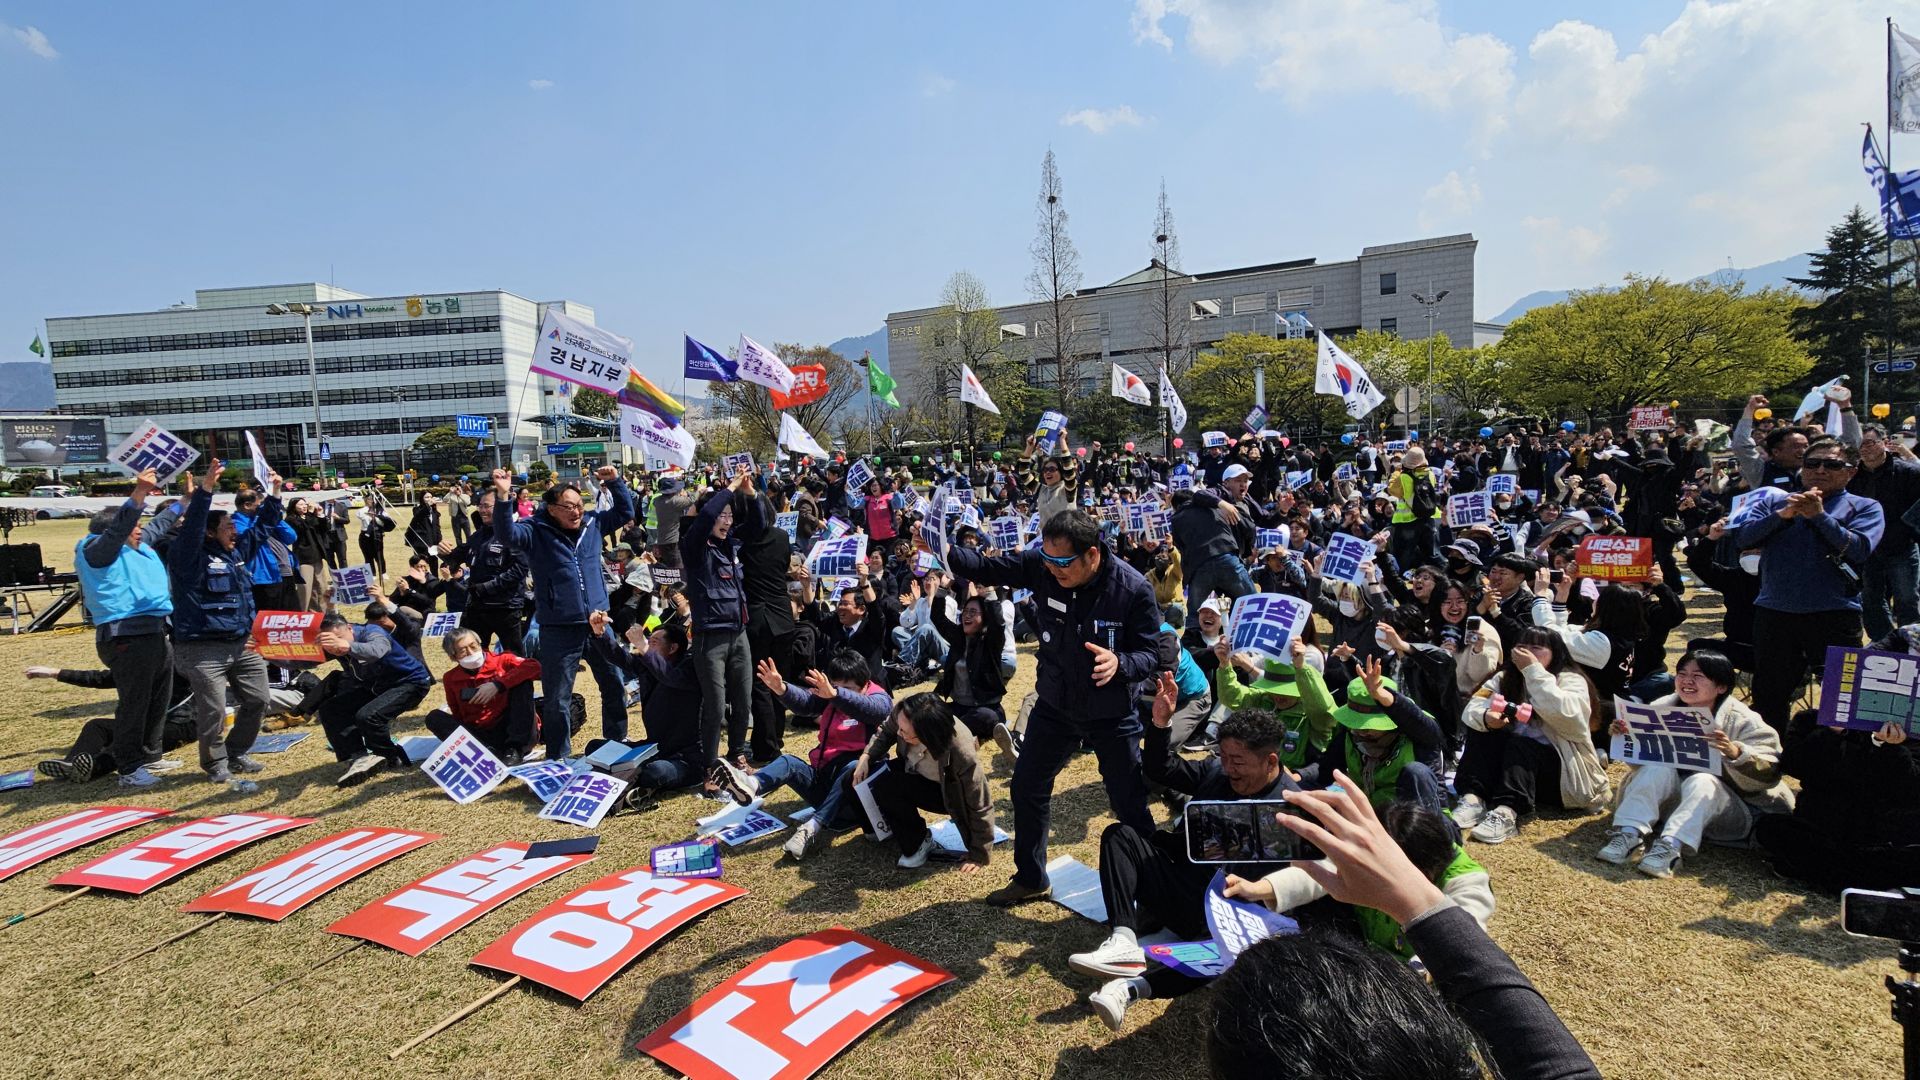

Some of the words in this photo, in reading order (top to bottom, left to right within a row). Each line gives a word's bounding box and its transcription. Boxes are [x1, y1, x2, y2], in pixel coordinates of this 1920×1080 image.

[327, 304, 363, 319] NH
[426, 297, 460, 314] 농협
[891, 325, 920, 337] 한국은행
[550, 346, 622, 381] 경남지부
[147, 432, 190, 468] 구속
[1455, 494, 1484, 510] 구속
[991, 521, 1018, 537] 구속
[1456, 508, 1487, 525] 파면
[822, 538, 858, 556] 구속
[994, 533, 1020, 551] 파면
[1329, 536, 1365, 562] 구속
[1586, 538, 1640, 551] 내란수괴
[818, 556, 858, 576] 파면
[1323, 554, 1359, 581] 파면
[1579, 566, 1609, 577] 탄핵!
[1613, 565, 1648, 577] 체포!
[1591, 553, 1633, 566] 윤석열
[262, 614, 314, 629] 내란수괴
[433, 614, 457, 626] 구속
[1242, 597, 1297, 629] 구속
[267, 630, 304, 645] 윤석열
[1233, 622, 1290, 657] 파면
[1860, 655, 1920, 700] 완
[1625, 705, 1706, 737] 구속
[455, 740, 498, 785] 구속
[1634, 732, 1711, 769] 파면
[435, 758, 482, 800] 파면
[515, 768, 562, 797] 파면
[567, 774, 613, 801] 구속
[550, 795, 600, 822] 파면
[81, 814, 294, 880] 란
[209, 830, 422, 906] 세
[383, 850, 574, 941] 력
[669, 941, 923, 1080] 산
